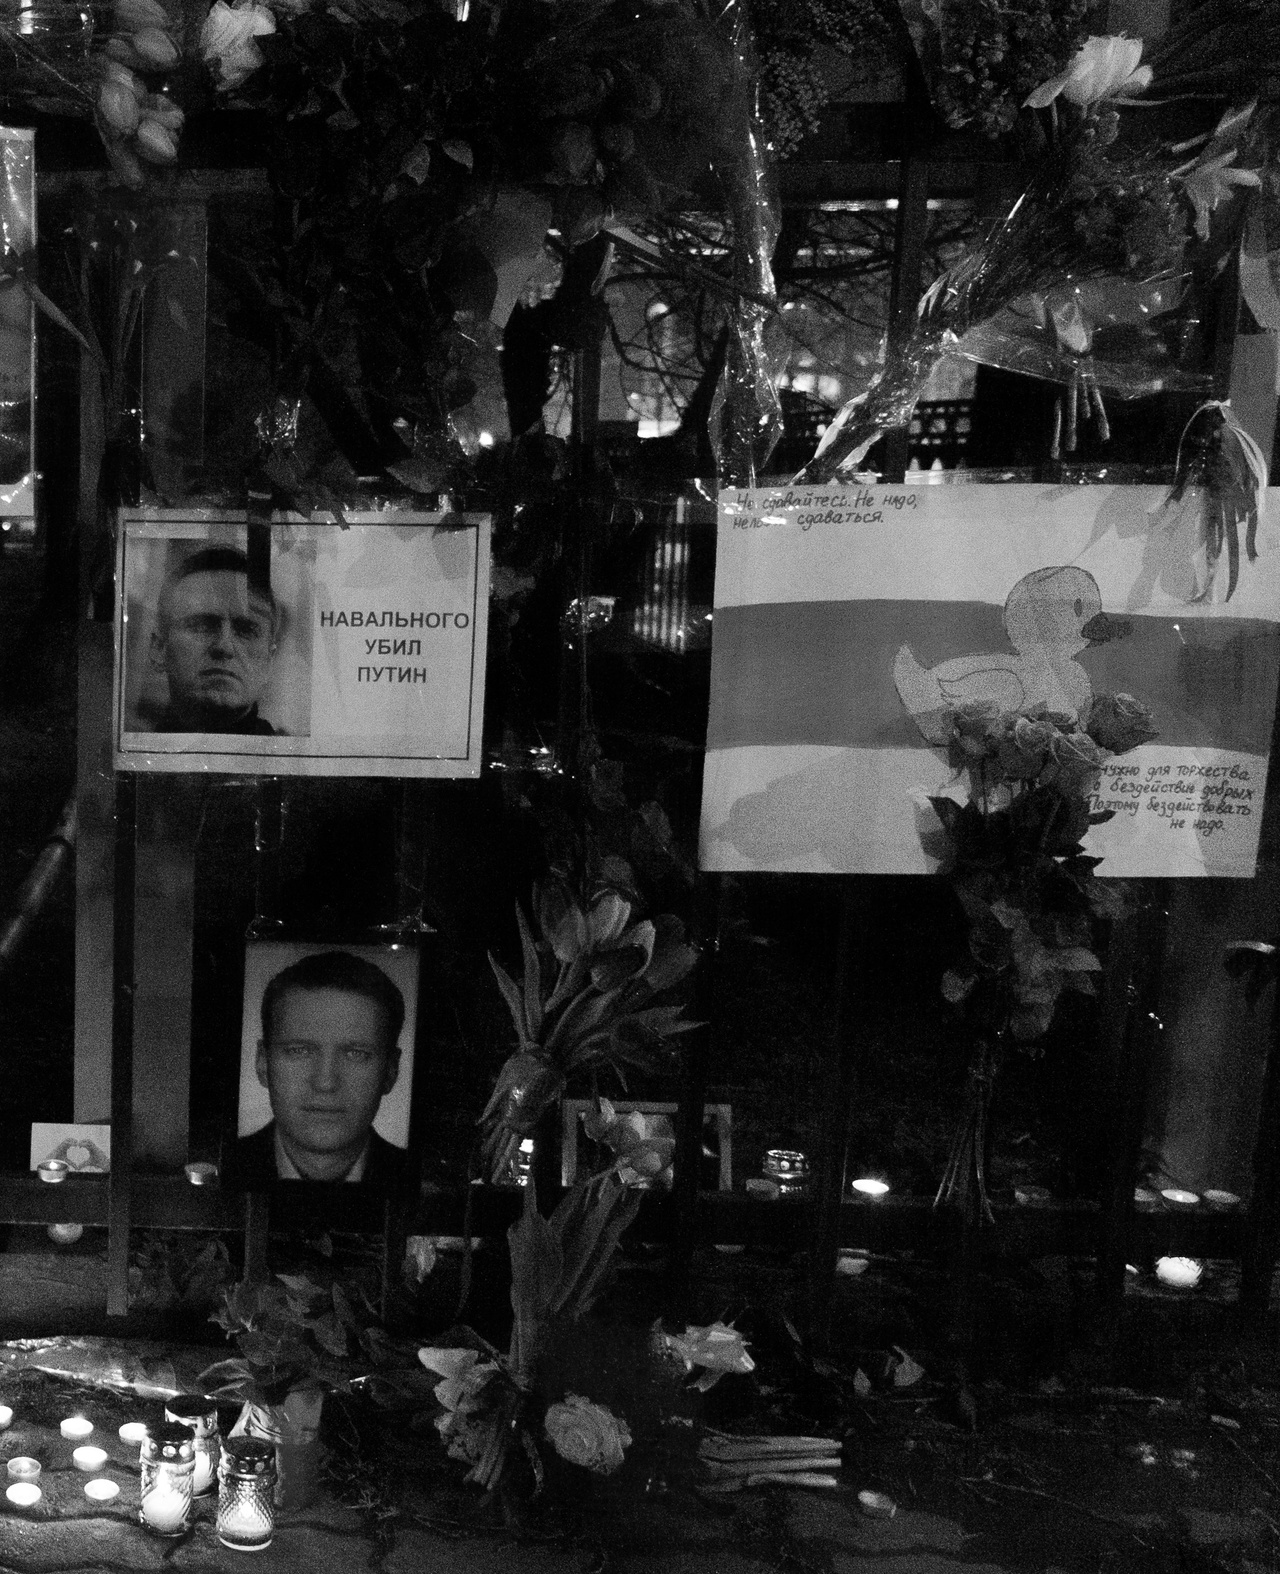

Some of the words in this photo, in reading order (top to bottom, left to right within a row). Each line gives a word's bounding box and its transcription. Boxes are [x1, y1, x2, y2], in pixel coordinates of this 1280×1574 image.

[855, 490, 874, 508] Не
[797, 510, 884, 531] сдаваться.
[320, 610, 470, 629] НАВАЛЬНОГО
[364, 638, 422, 656] УБИЛ
[357, 666, 427, 683] ПУТИН
[1145, 765, 1171, 782] для
[1176, 763, 1252, 781] торжества
[1200, 779, 1255, 801] добрых
[1169, 818, 1185, 830] не
